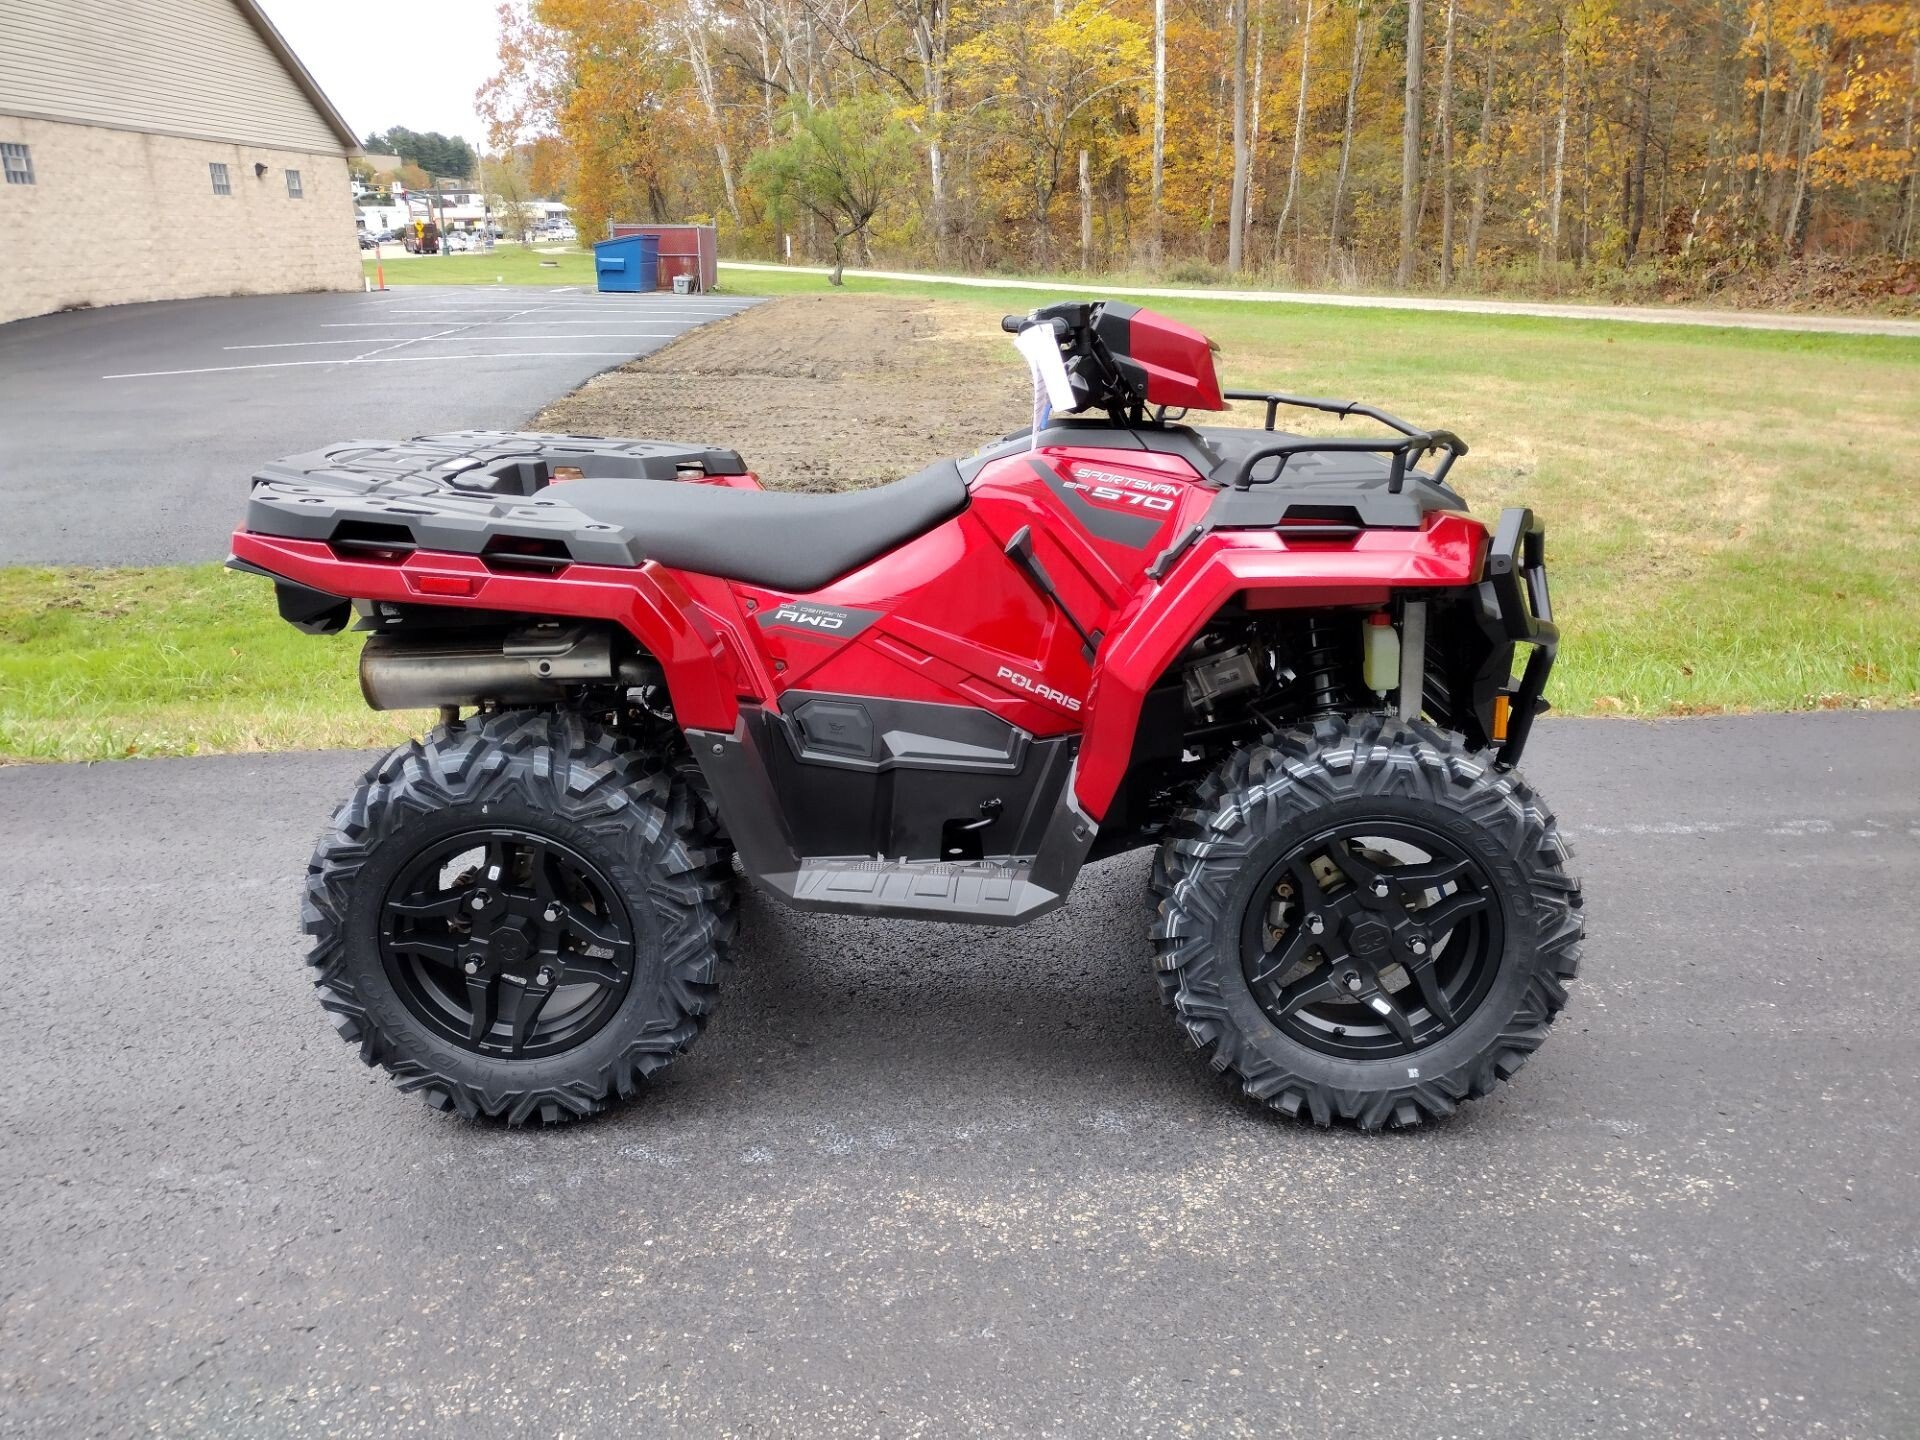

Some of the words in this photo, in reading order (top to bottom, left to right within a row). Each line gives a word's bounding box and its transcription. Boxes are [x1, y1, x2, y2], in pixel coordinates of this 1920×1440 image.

[1074, 467, 1184, 497] SPORTSMAN
[1092, 486, 1174, 511] 570
[775, 610, 843, 629] AWD
[997, 665, 1082, 712] POLARIS
